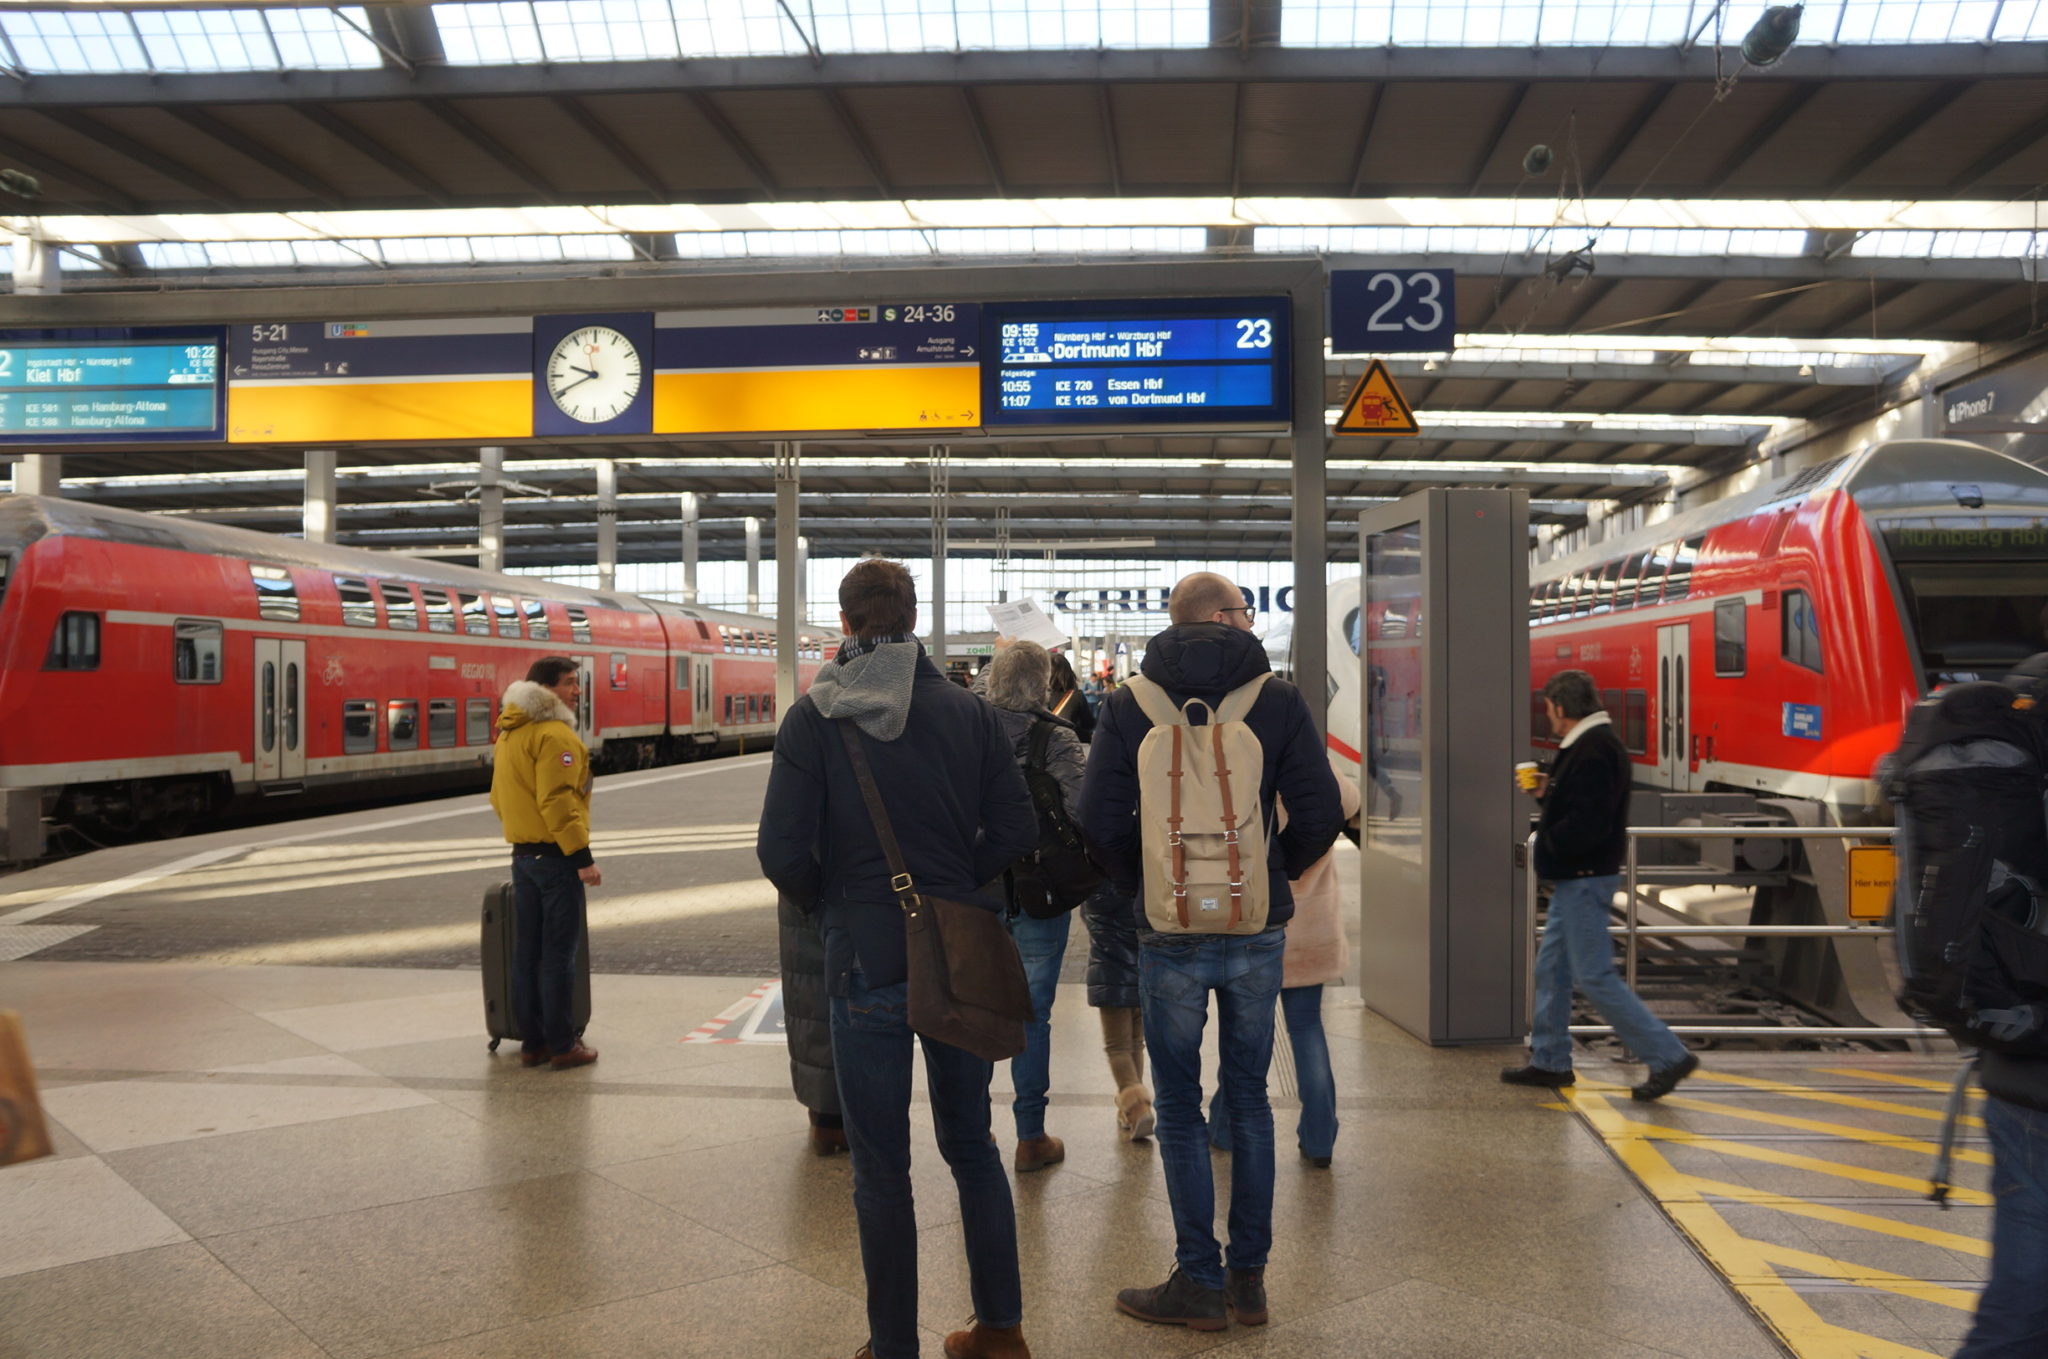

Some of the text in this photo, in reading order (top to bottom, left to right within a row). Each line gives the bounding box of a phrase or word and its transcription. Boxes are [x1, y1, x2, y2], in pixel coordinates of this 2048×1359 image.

[1367, 272, 1443, 332] 23
[885, 308, 896, 321] S
[904, 305, 955, 323] 24-36
[252, 324, 287, 341] 5-21
[1003, 324, 1039, 337] 09:55
[1054, 331, 1172, 343] Nürnberg Hbf Würzburg Hbf
[1236, 319, 1272, 348] 23
[928, 337, 954, 345] Ausgang
[185, 346, 216, 358] 10:22
[1054, 341, 1163, 359] Dortmund Hbf
[27, 368, 82, 383] Kiel Hbf
[1002, 379, 1163, 392] 10:55 ICE 720 Essen Hbf
[1002, 392, 1206, 406] 11:07 ICE 1125 von Dortmund Hbf
[26, 404, 40, 412] ICE
[92, 402, 166, 413] Hamburg-Altona
[1956, 391, 1995, 422] iPhone 7
[26, 417, 40, 426] ICE
[72, 416, 145, 427] Hamburg-Altona
[1117, 642, 1127, 654] A
